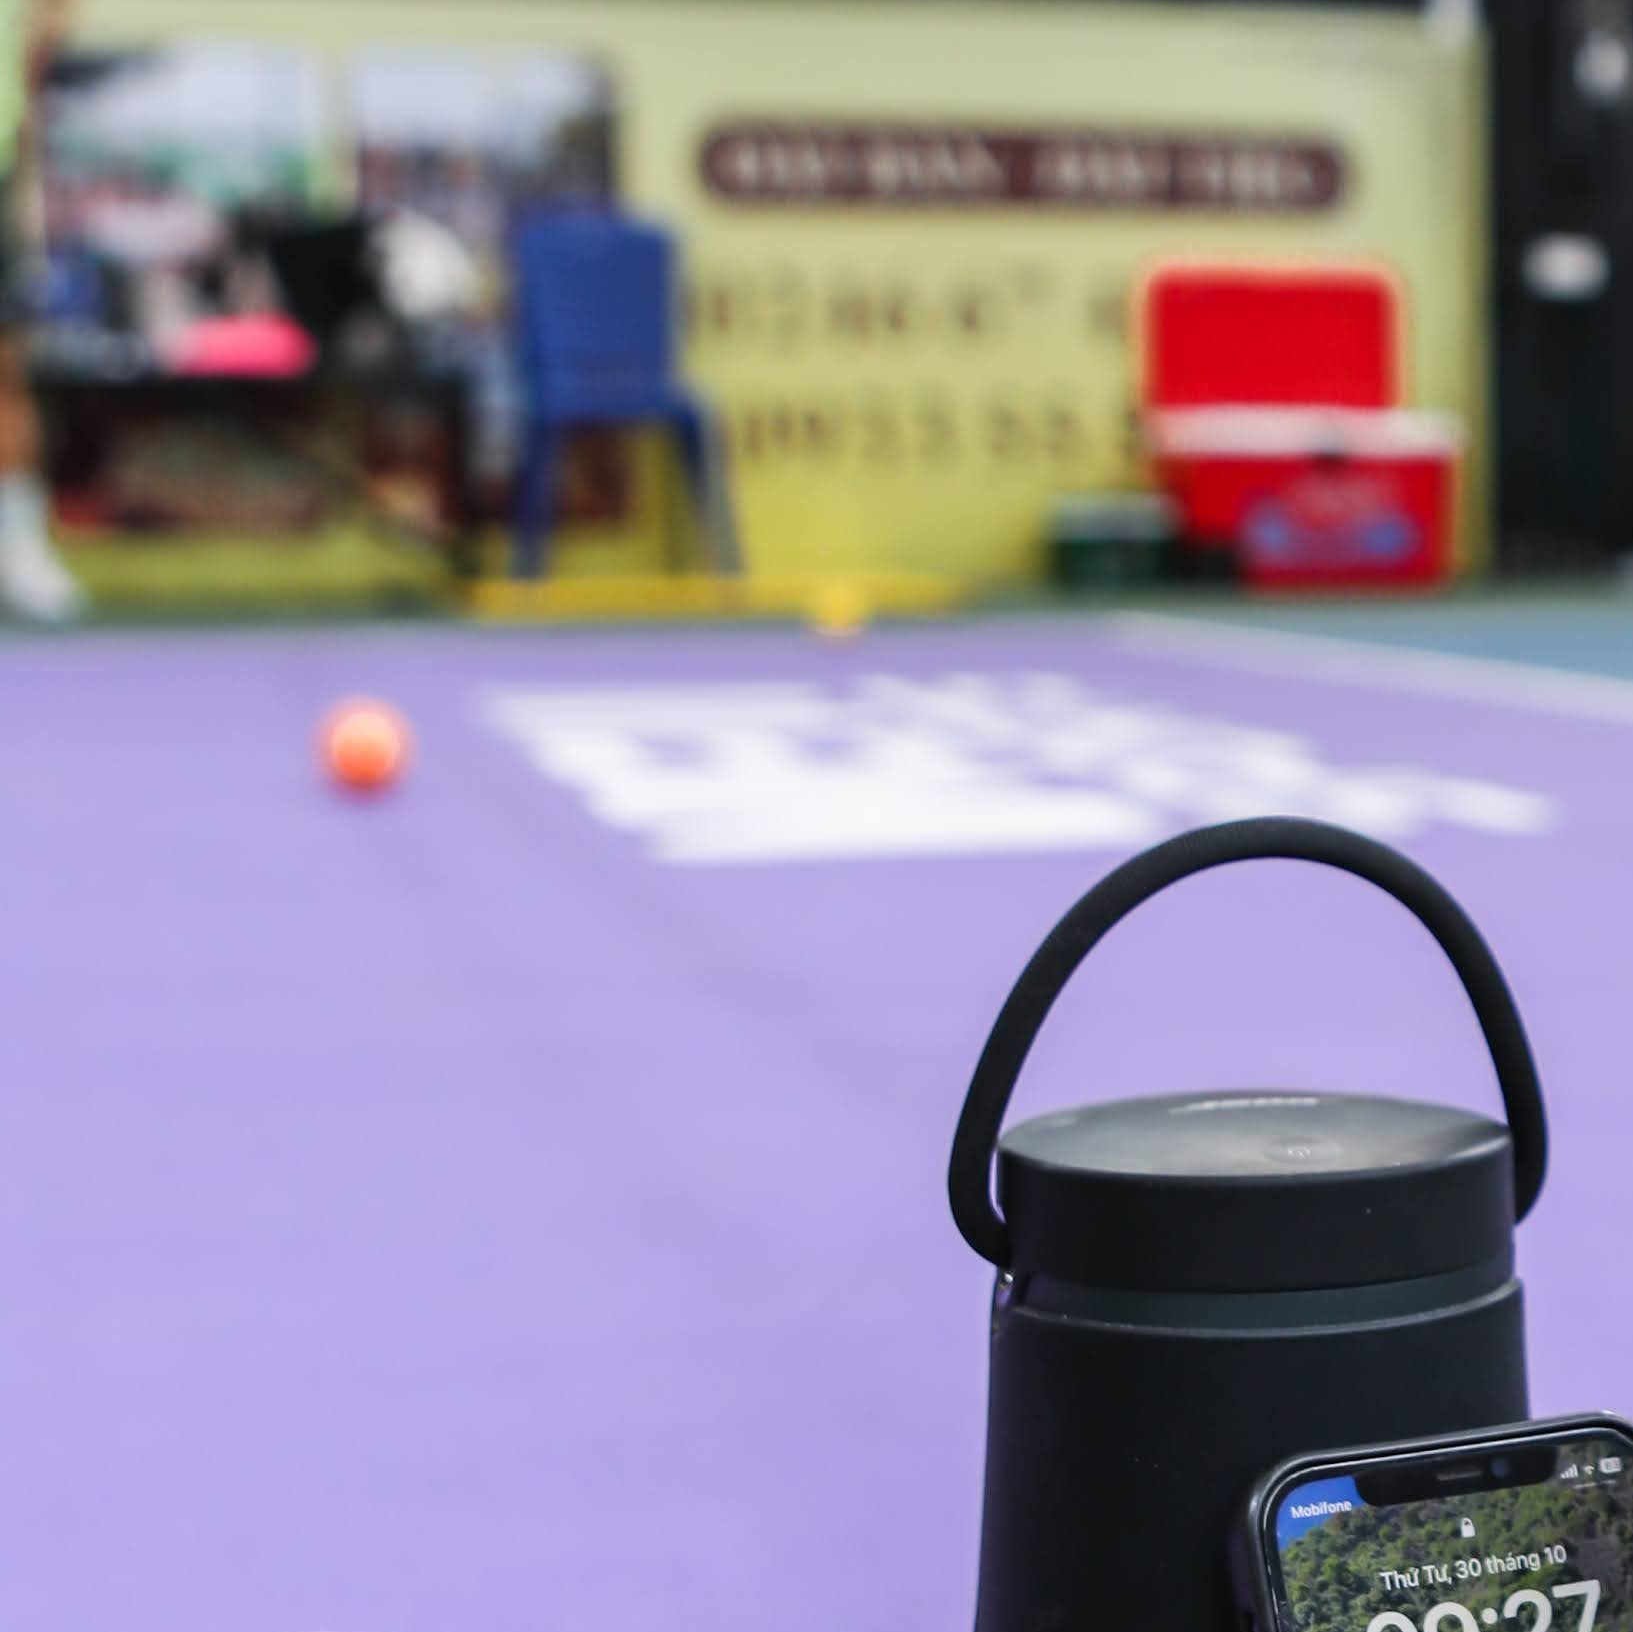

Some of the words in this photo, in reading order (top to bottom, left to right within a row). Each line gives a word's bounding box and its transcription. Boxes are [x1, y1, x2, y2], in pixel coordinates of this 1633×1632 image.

[1291, 1500, 1352, 1519] Mobifone
[1380, 1567, 1420, 1591] Thứ
[1455, 1557, 1482, 1579] 30
[1485, 1551, 1541, 1575] tháng
[1544, 1544, 1567, 1565] 10
